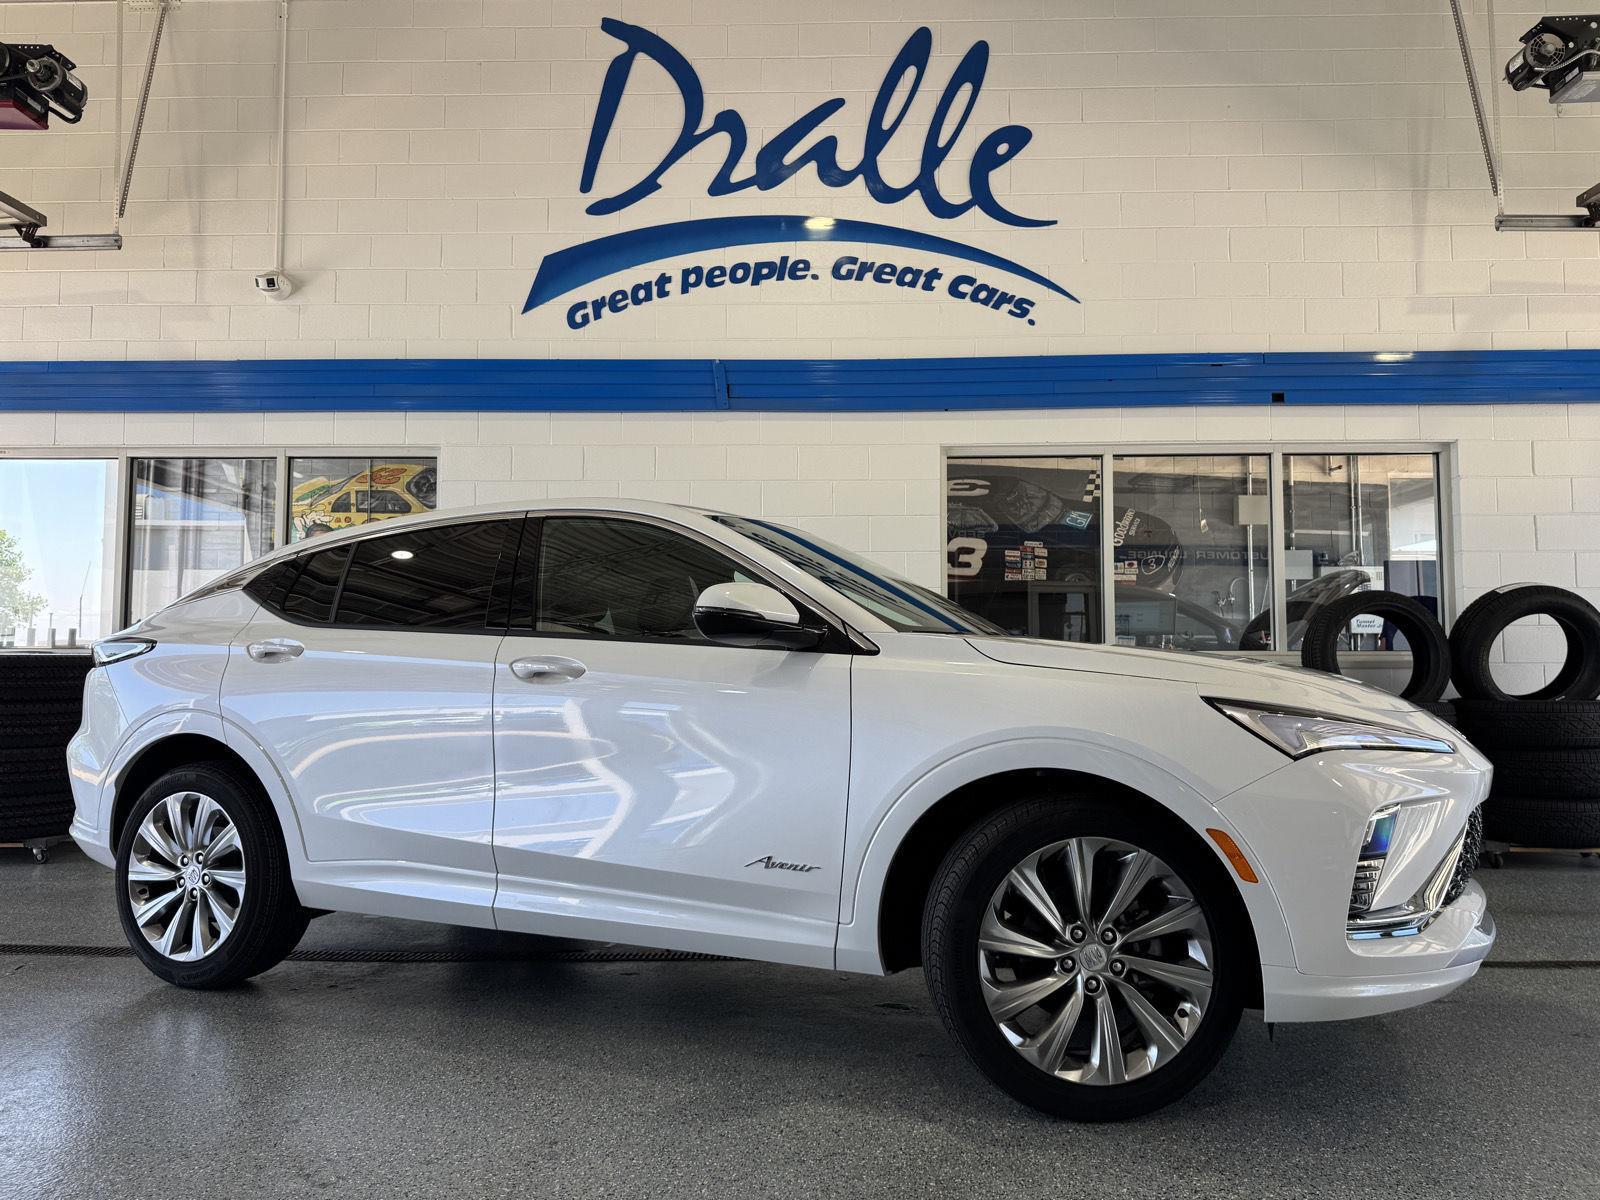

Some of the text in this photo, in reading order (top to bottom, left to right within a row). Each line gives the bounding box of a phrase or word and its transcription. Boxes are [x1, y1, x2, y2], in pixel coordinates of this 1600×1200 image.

[580, 17, 1058, 228] Dralle
[566, 272, 672, 330] Great
[831, 255, 944, 292] Great
[947, 274, 1036, 326] Cars.
[947, 536, 988, 576] 3
[1147, 557, 1157, 570] 3
[743, 855, 822, 873] Avenir
